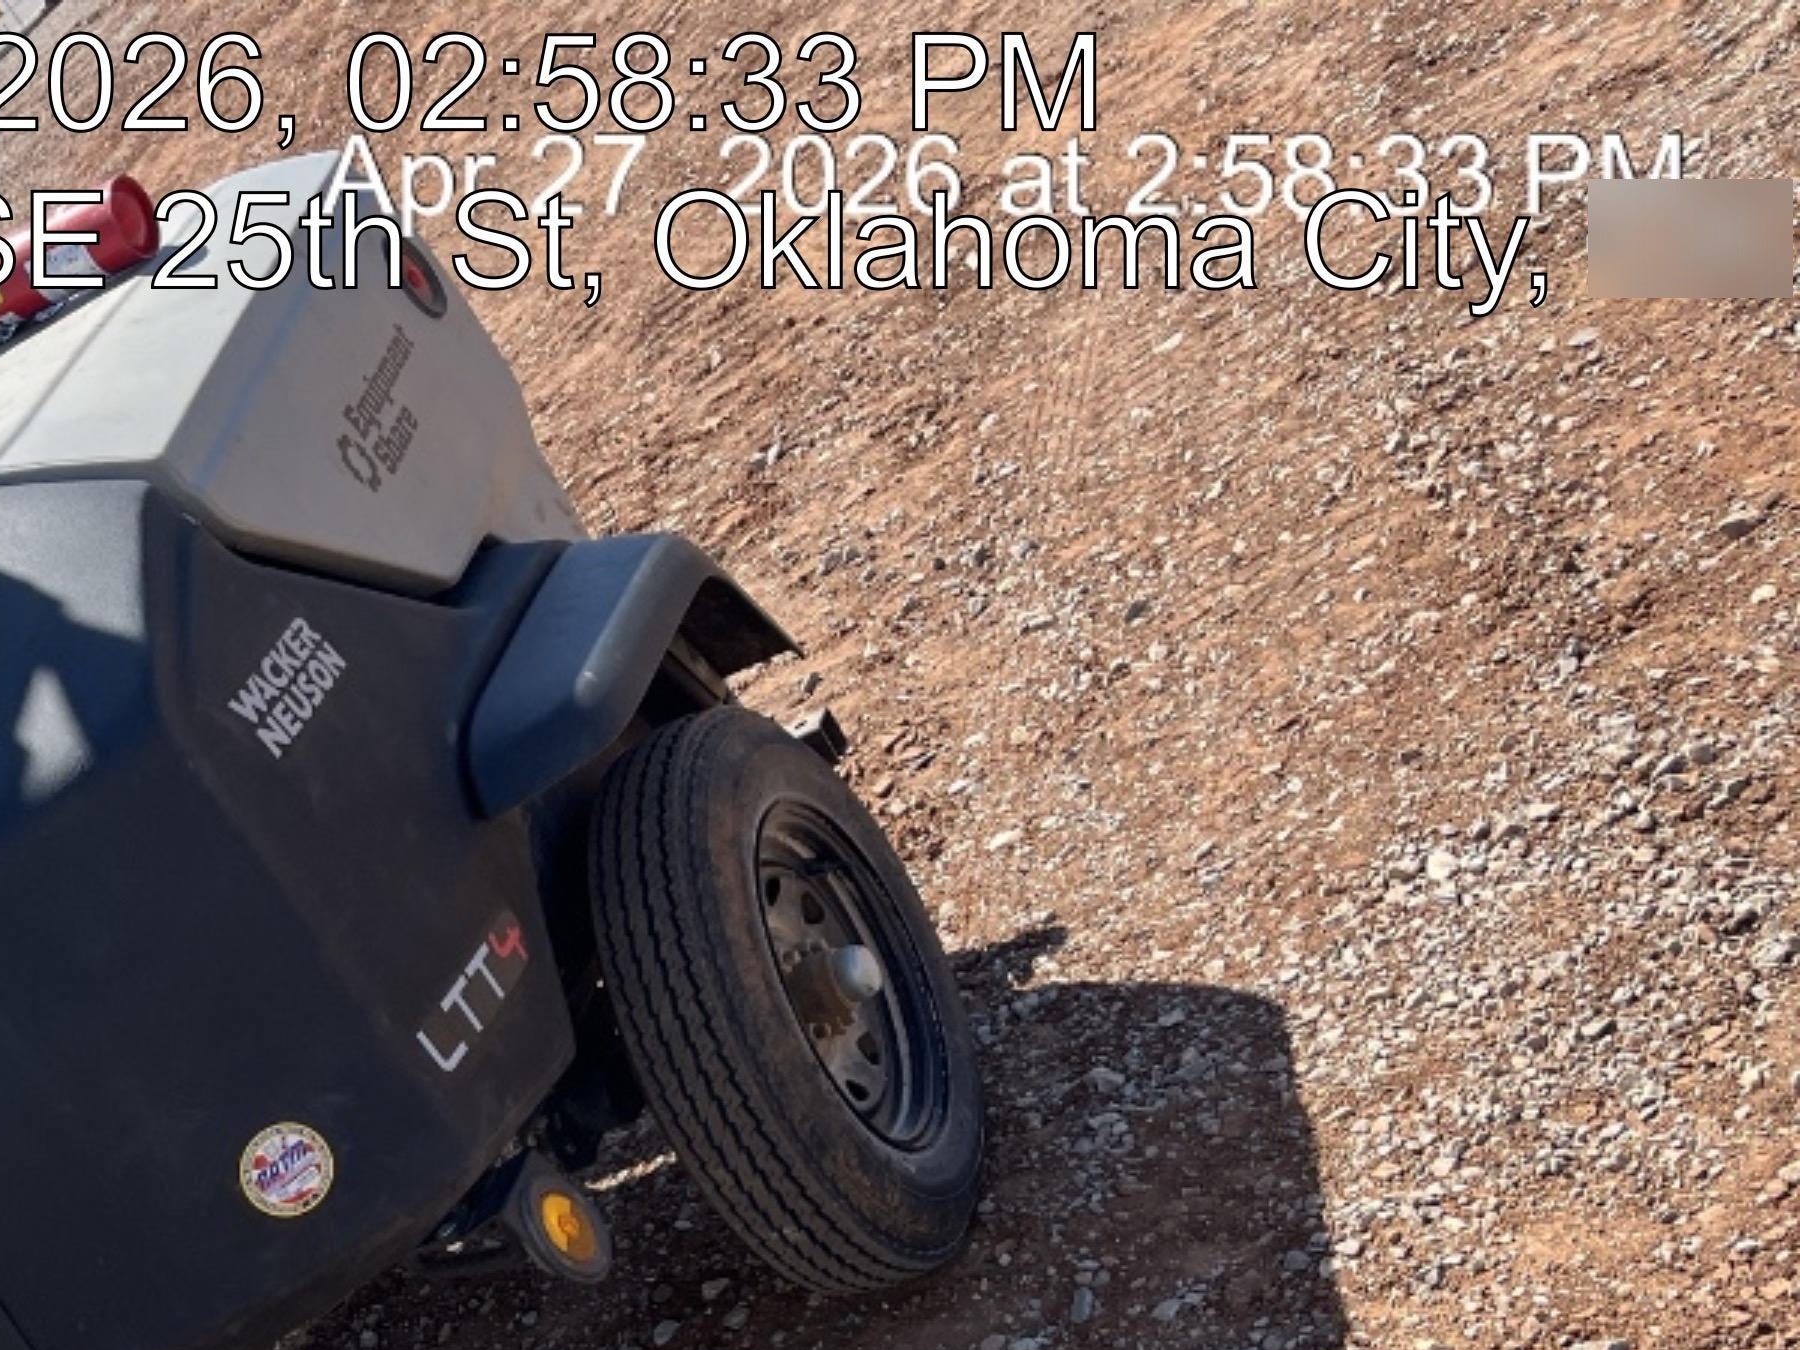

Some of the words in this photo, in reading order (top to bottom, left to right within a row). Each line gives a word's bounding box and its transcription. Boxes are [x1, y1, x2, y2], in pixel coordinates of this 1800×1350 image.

[343, 323, 415, 441] Equipment
[373, 404, 419, 475] Share
[227, 616, 322, 724] WACKER
[256, 642, 347, 760] NEUSON
